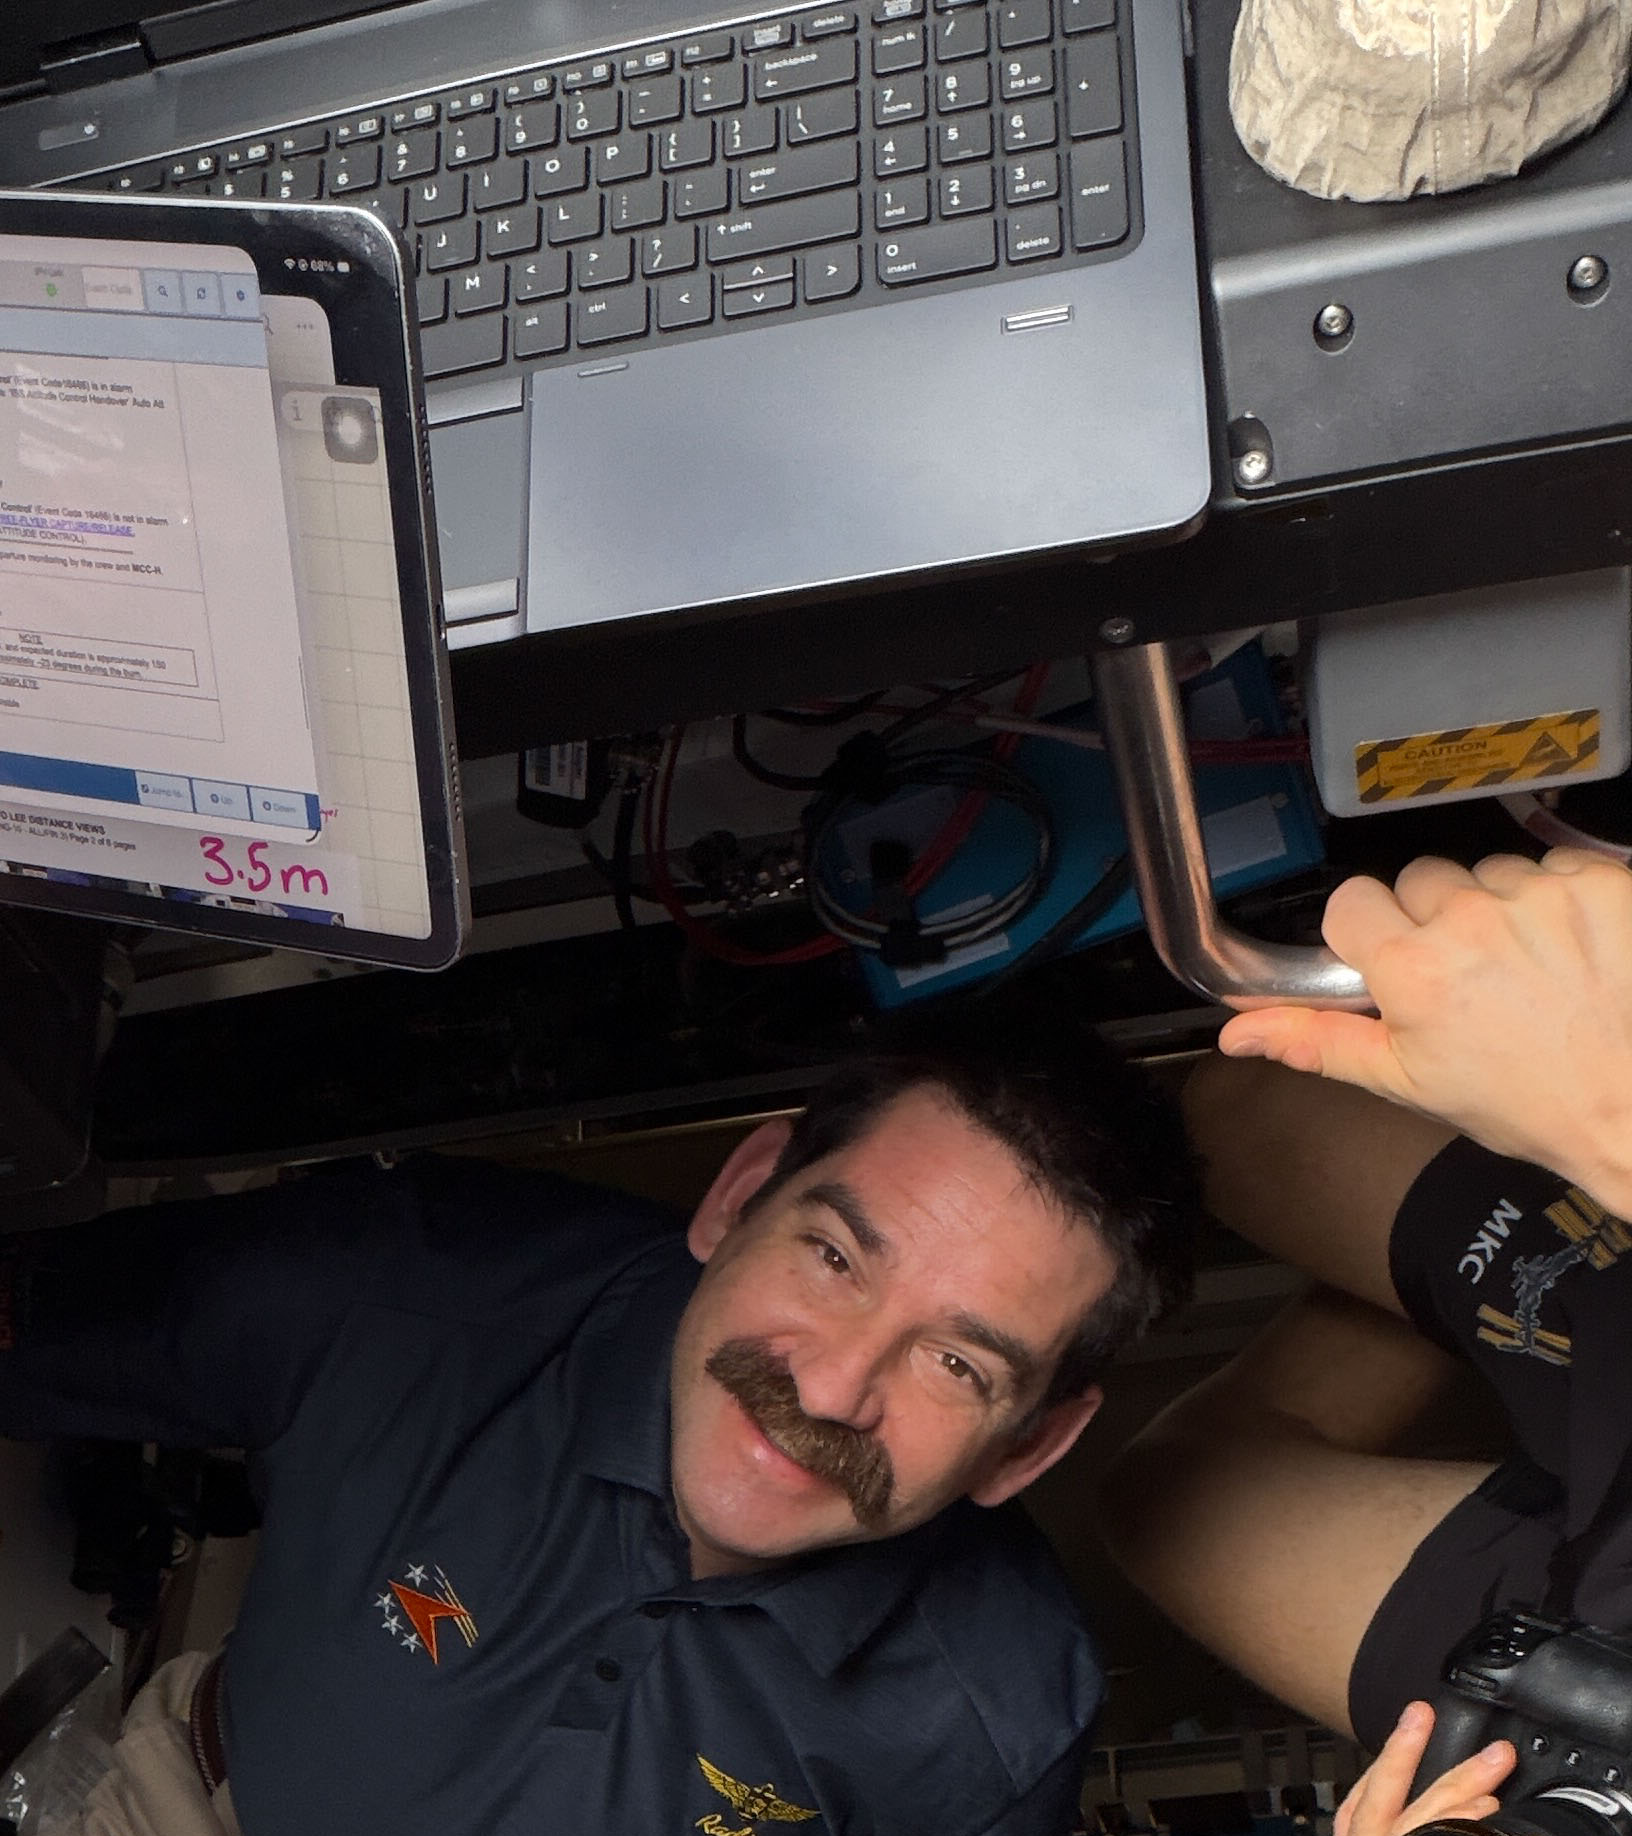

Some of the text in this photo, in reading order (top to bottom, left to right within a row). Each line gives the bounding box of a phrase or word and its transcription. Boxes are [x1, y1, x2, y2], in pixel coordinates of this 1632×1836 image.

[1009, 63, 1021, 76] 9
[945, 76, 957, 89] 8
[884, 88, 894, 101] 7
[882, 101, 913, 114] home
[1010, 115, 1023, 128] 6
[515, 131, 526, 143] 9
[947, 128, 959, 140] 5
[606, 146, 619, 159] P
[883, 140, 895, 153] 4
[397, 159, 407, 173] 7
[544, 158, 561, 173] O
[748, 165, 776, 179] enter
[337, 172, 349, 186] 6
[1014, 167, 1025, 180] 3
[280, 185, 291, 199] 5
[948, 179, 960, 192] 2
[1081, 183, 1110, 196] enter
[424, 186, 438, 200] U
[885, 192, 892, 204] 1
[558, 205, 569, 220] L
[884, 205, 906, 217] end
[496, 219, 510, 233] K
[730, 220, 753, 233] shift
[436, 232, 447, 248] J
[1016, 235, 1050, 250] delete
[886, 244, 898, 257] 0
[887, 261, 918, 275] insert
[465, 275, 480, 289] M
[588, 301, 607, 313] ctrl
[1403, 739, 1489, 762] CAUTION
[9, 812, 27, 824] LEE
[27, 814, 74, 831] DISTANCE
[74, 822, 106, 836] VIEWS
[1456, 1197, 1524, 1285] MKC
